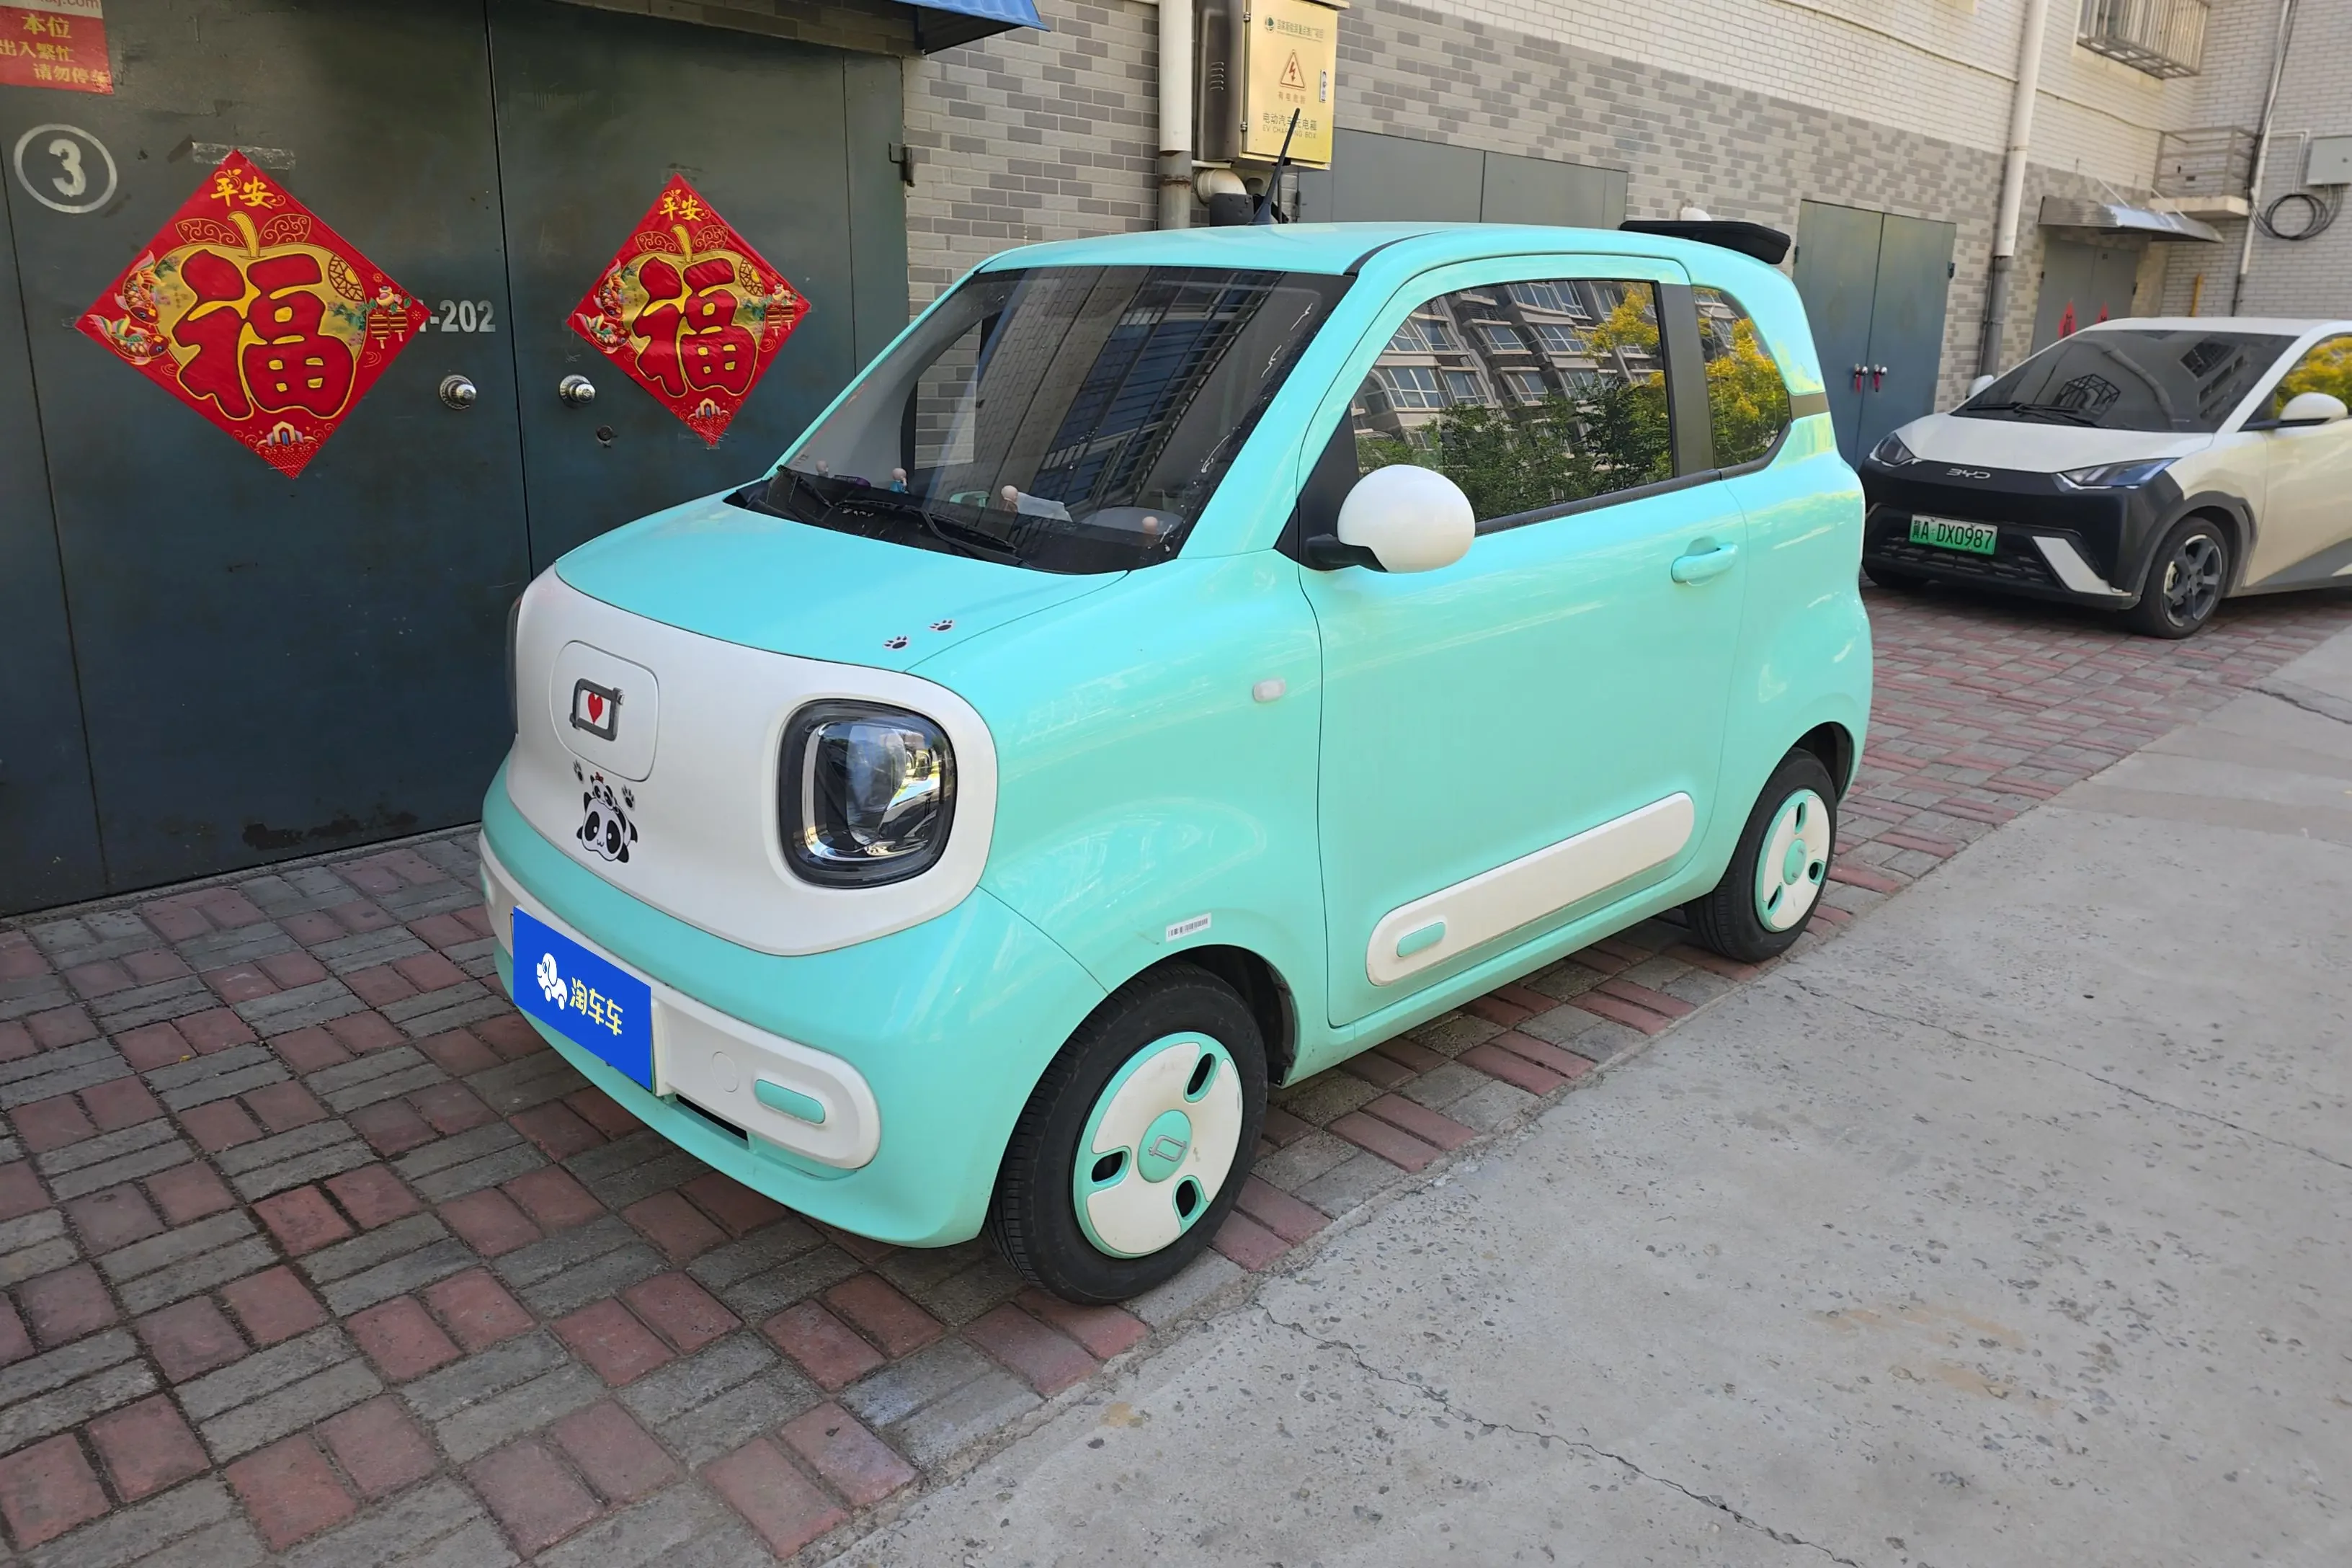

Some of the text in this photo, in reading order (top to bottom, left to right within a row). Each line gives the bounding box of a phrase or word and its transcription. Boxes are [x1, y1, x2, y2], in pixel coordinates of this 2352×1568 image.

[0, 39, 75, 63] 出入繁忙
[49, 139, 86, 197] 3
[210, 174, 276, 209] 平安
[659, 195, 705, 222] 平安
[172, 249, 357, 420] 福
[632, 256, 757, 397] 福
[1946, 468, 1990, 479] BYD
